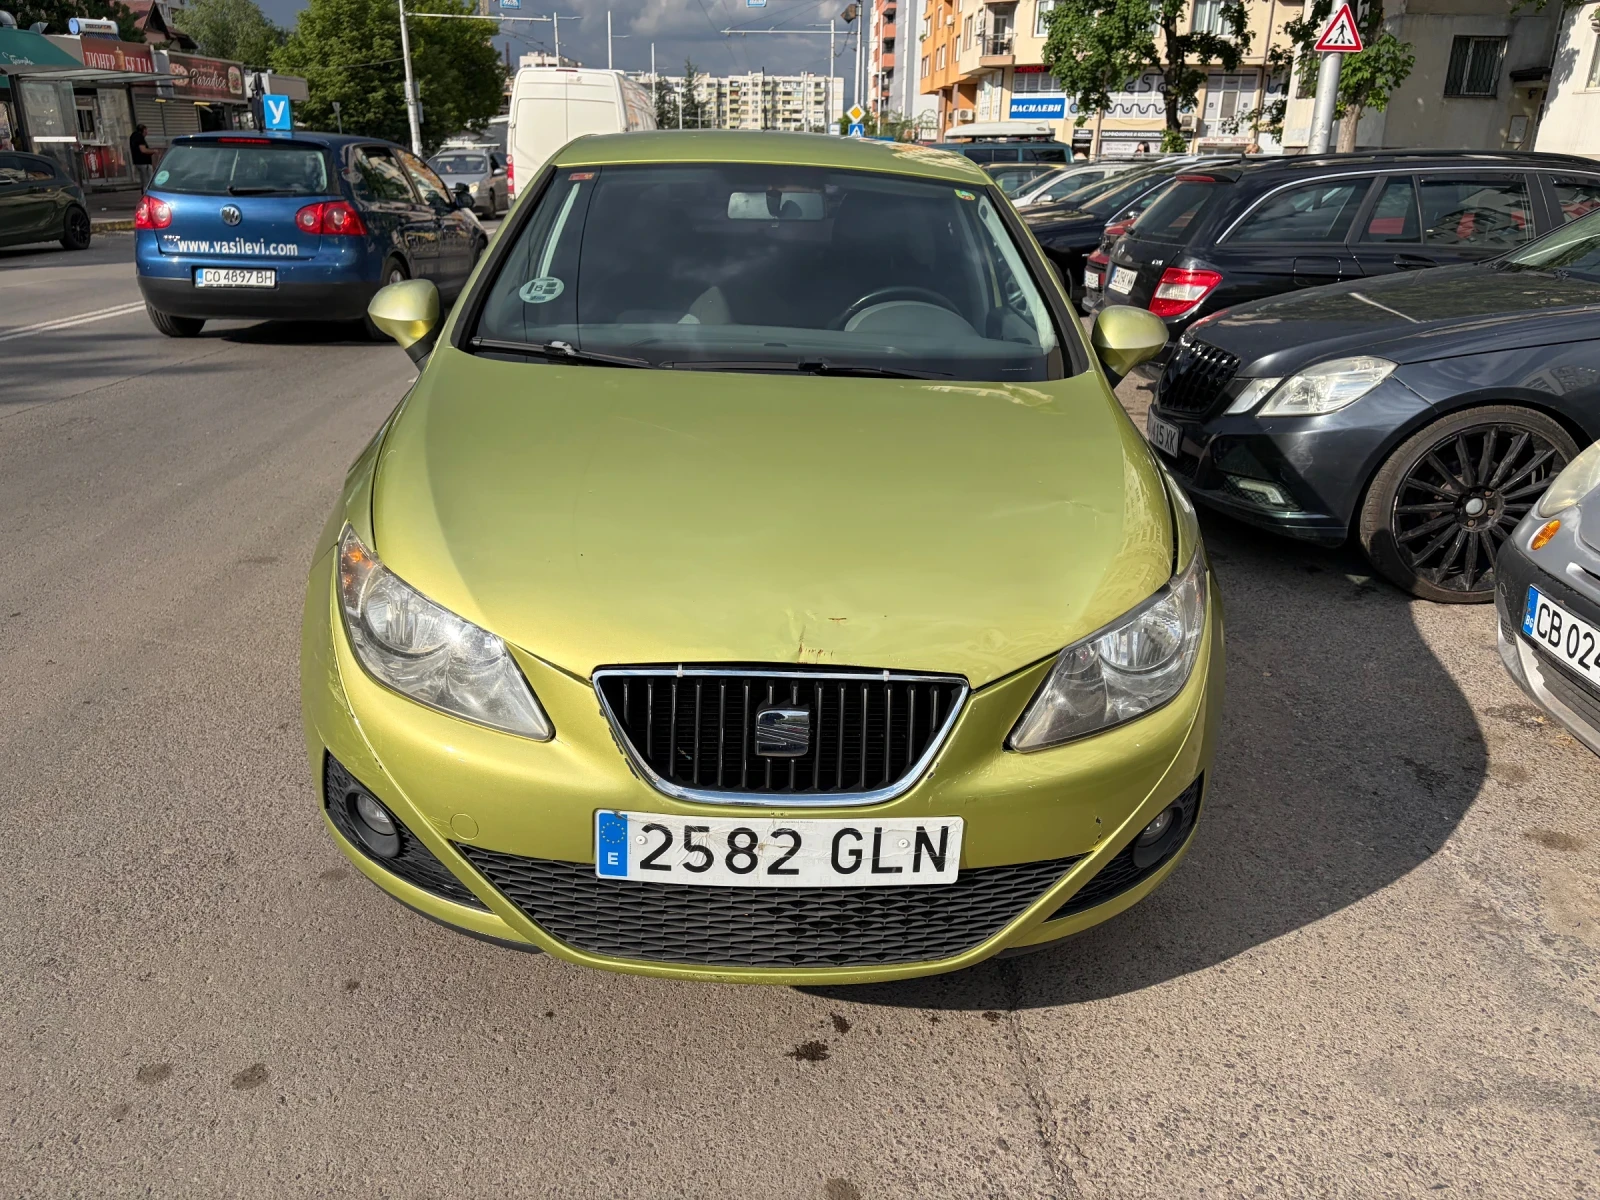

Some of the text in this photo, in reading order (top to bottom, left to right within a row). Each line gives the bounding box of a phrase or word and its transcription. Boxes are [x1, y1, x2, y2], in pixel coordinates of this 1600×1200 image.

[189, 68, 227, 88] Paradise
[1010, 104, 1062, 112] ВАСИЛЕВИ
[178, 237, 298, 256] www.vasilevi.com
[223, 271, 254, 283] 4897
[1537, 603, 1562, 648] CB
[608, 852, 618, 866] E
[639, 823, 949, 876] 2582 GLN
